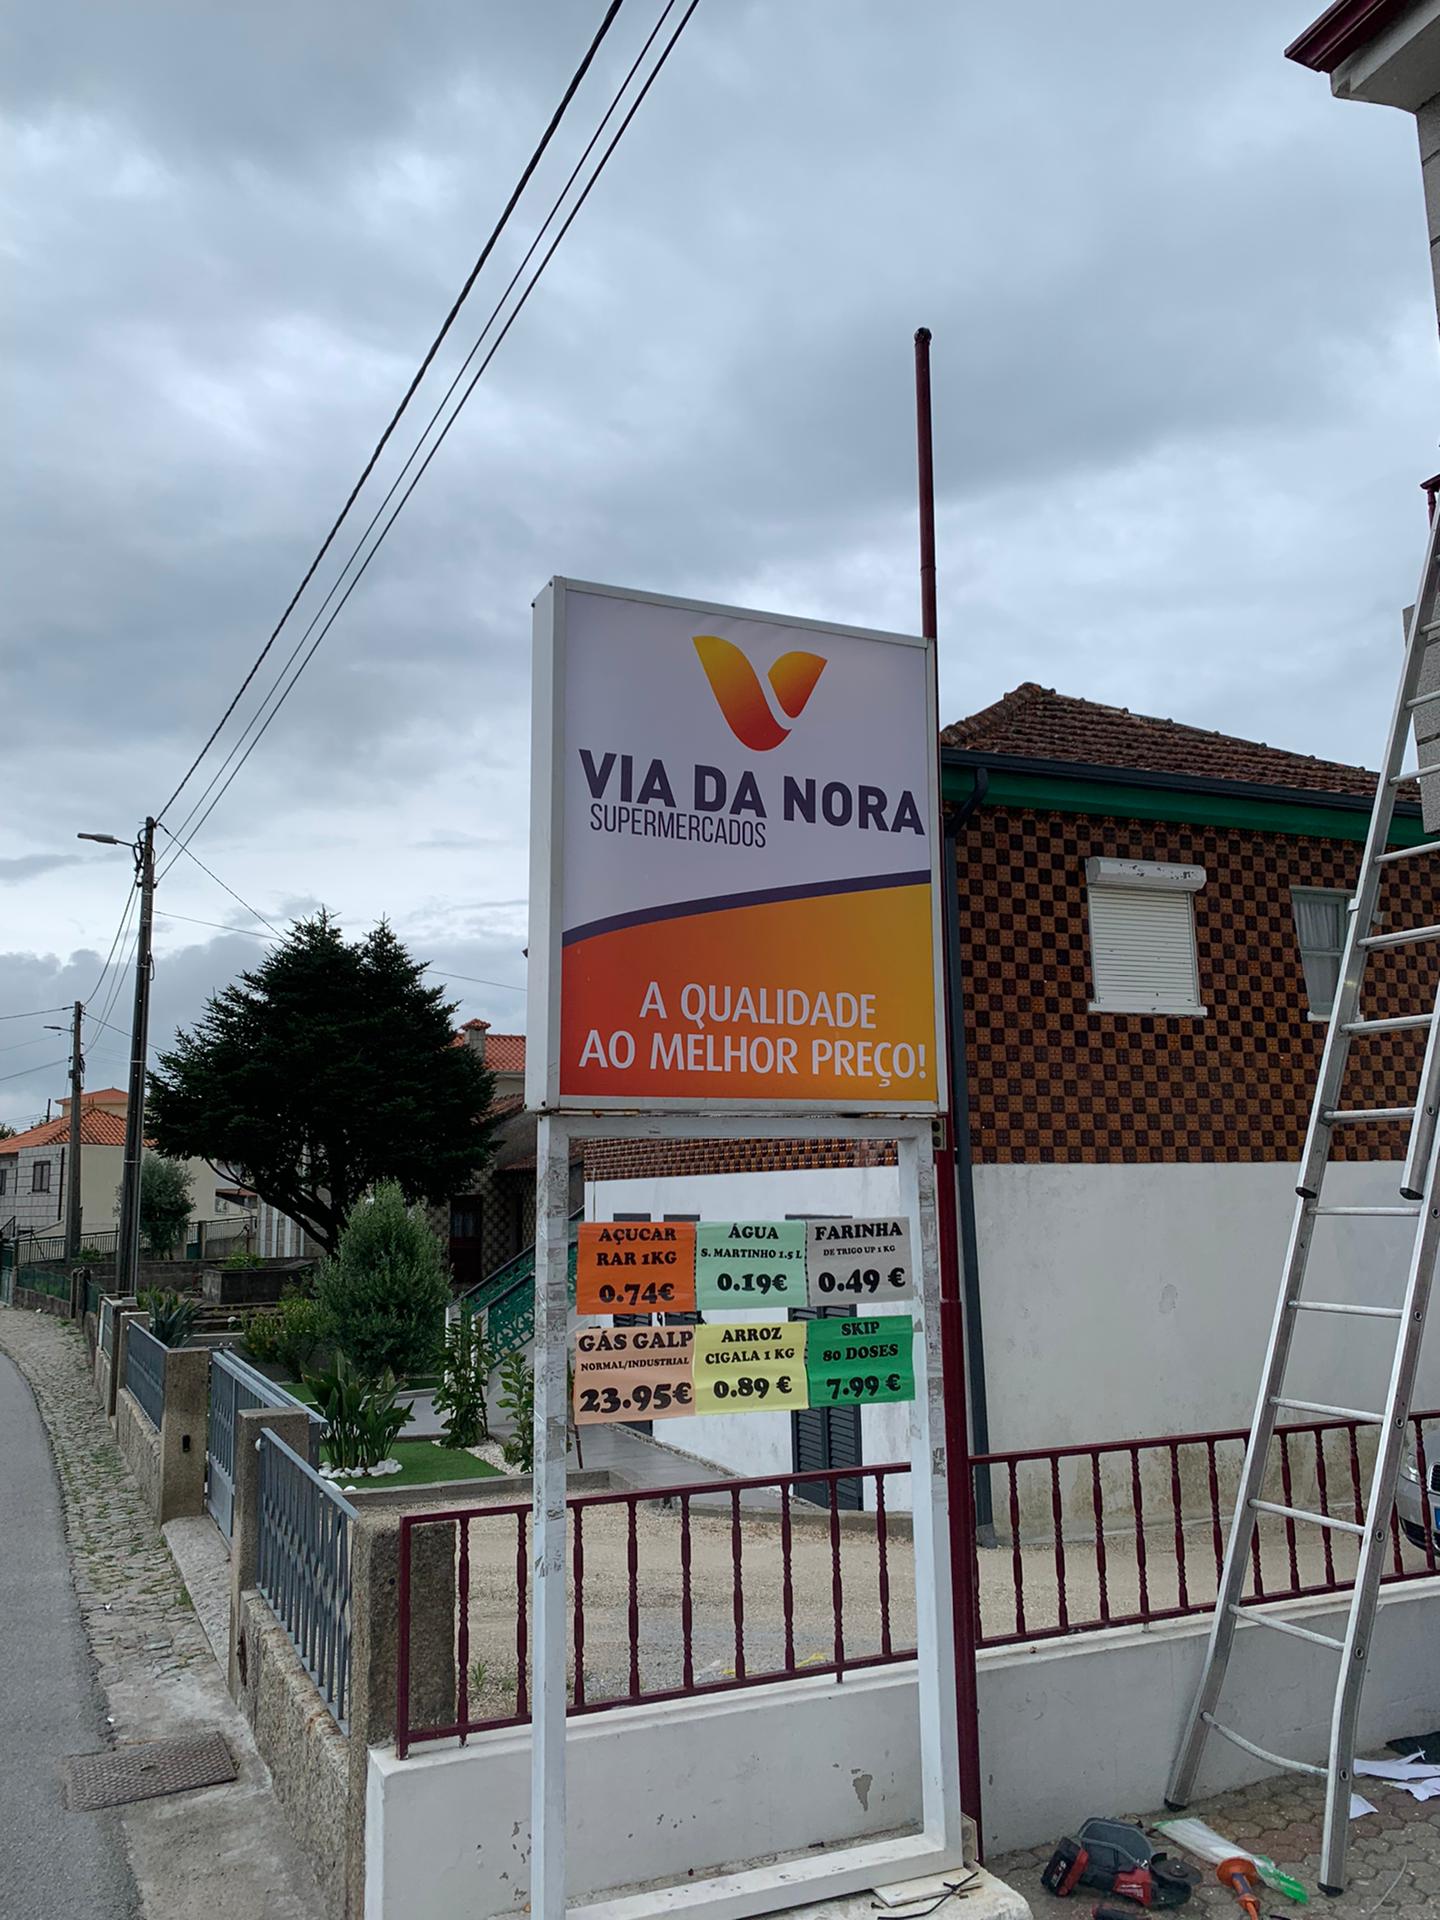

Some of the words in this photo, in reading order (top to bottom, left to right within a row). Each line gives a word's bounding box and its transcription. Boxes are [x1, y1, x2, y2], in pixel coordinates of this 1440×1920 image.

[578, 749, 677, 808] VIA
[694, 764, 767, 818] DA
[783, 776, 926, 836] NORA
[590, 803, 767, 848] SUPERMERCADOS
[639, 981, 667, 1019] A
[680, 983, 877, 1030] QUALIDADE
[578, 1029, 636, 1069] AO
[650, 1033, 798, 1075] MELHOR
[811, 1038, 928, 1087] PREÇO!
[598, 1227, 677, 1246] AÇUCAR
[728, 1223, 779, 1240] ÁGUA
[814, 1222, 903, 1241] FARINHA
[596, 1252, 636, 1266] RAR
[641, 1251, 678, 1265] 1KG
[700, 1249, 712, 1257] S.
[716, 1249, 776, 1259] MARTINHO
[777, 1250, 794, 1260] 1.5
[795, 1249, 802, 1259] L
[823, 1248, 835, 1256] DE
[837, 1247, 861, 1255] TRIGO
[863, 1246, 876, 1255] UP
[717, 1273, 788, 1295] 0.19€
[818, 1269, 881, 1294] 0.49
[888, 1267, 906, 1288] €
[599, 1283, 676, 1305] 0.74€
[721, 1327, 782, 1343] ARROZ
[841, 1321, 880, 1336] SKIP
[578, 1331, 627, 1352] GÁS
[633, 1331, 693, 1348] GALP
[705, 1350, 761, 1365] CIGALA
[764, 1350, 770, 1361] 1
[773, 1348, 795, 1360] KG
[822, 1349, 841, 1362] 80
[844, 1344, 899, 1360] DOSES
[581, 1356, 690, 1372] NORMAL/INDUSTRIAL
[713, 1377, 770, 1399] 0.89
[776, 1375, 792, 1394] €
[826, 1376, 880, 1400] 7.99
[885, 1373, 901, 1392] €
[580, 1382, 693, 1414] 23.95€
